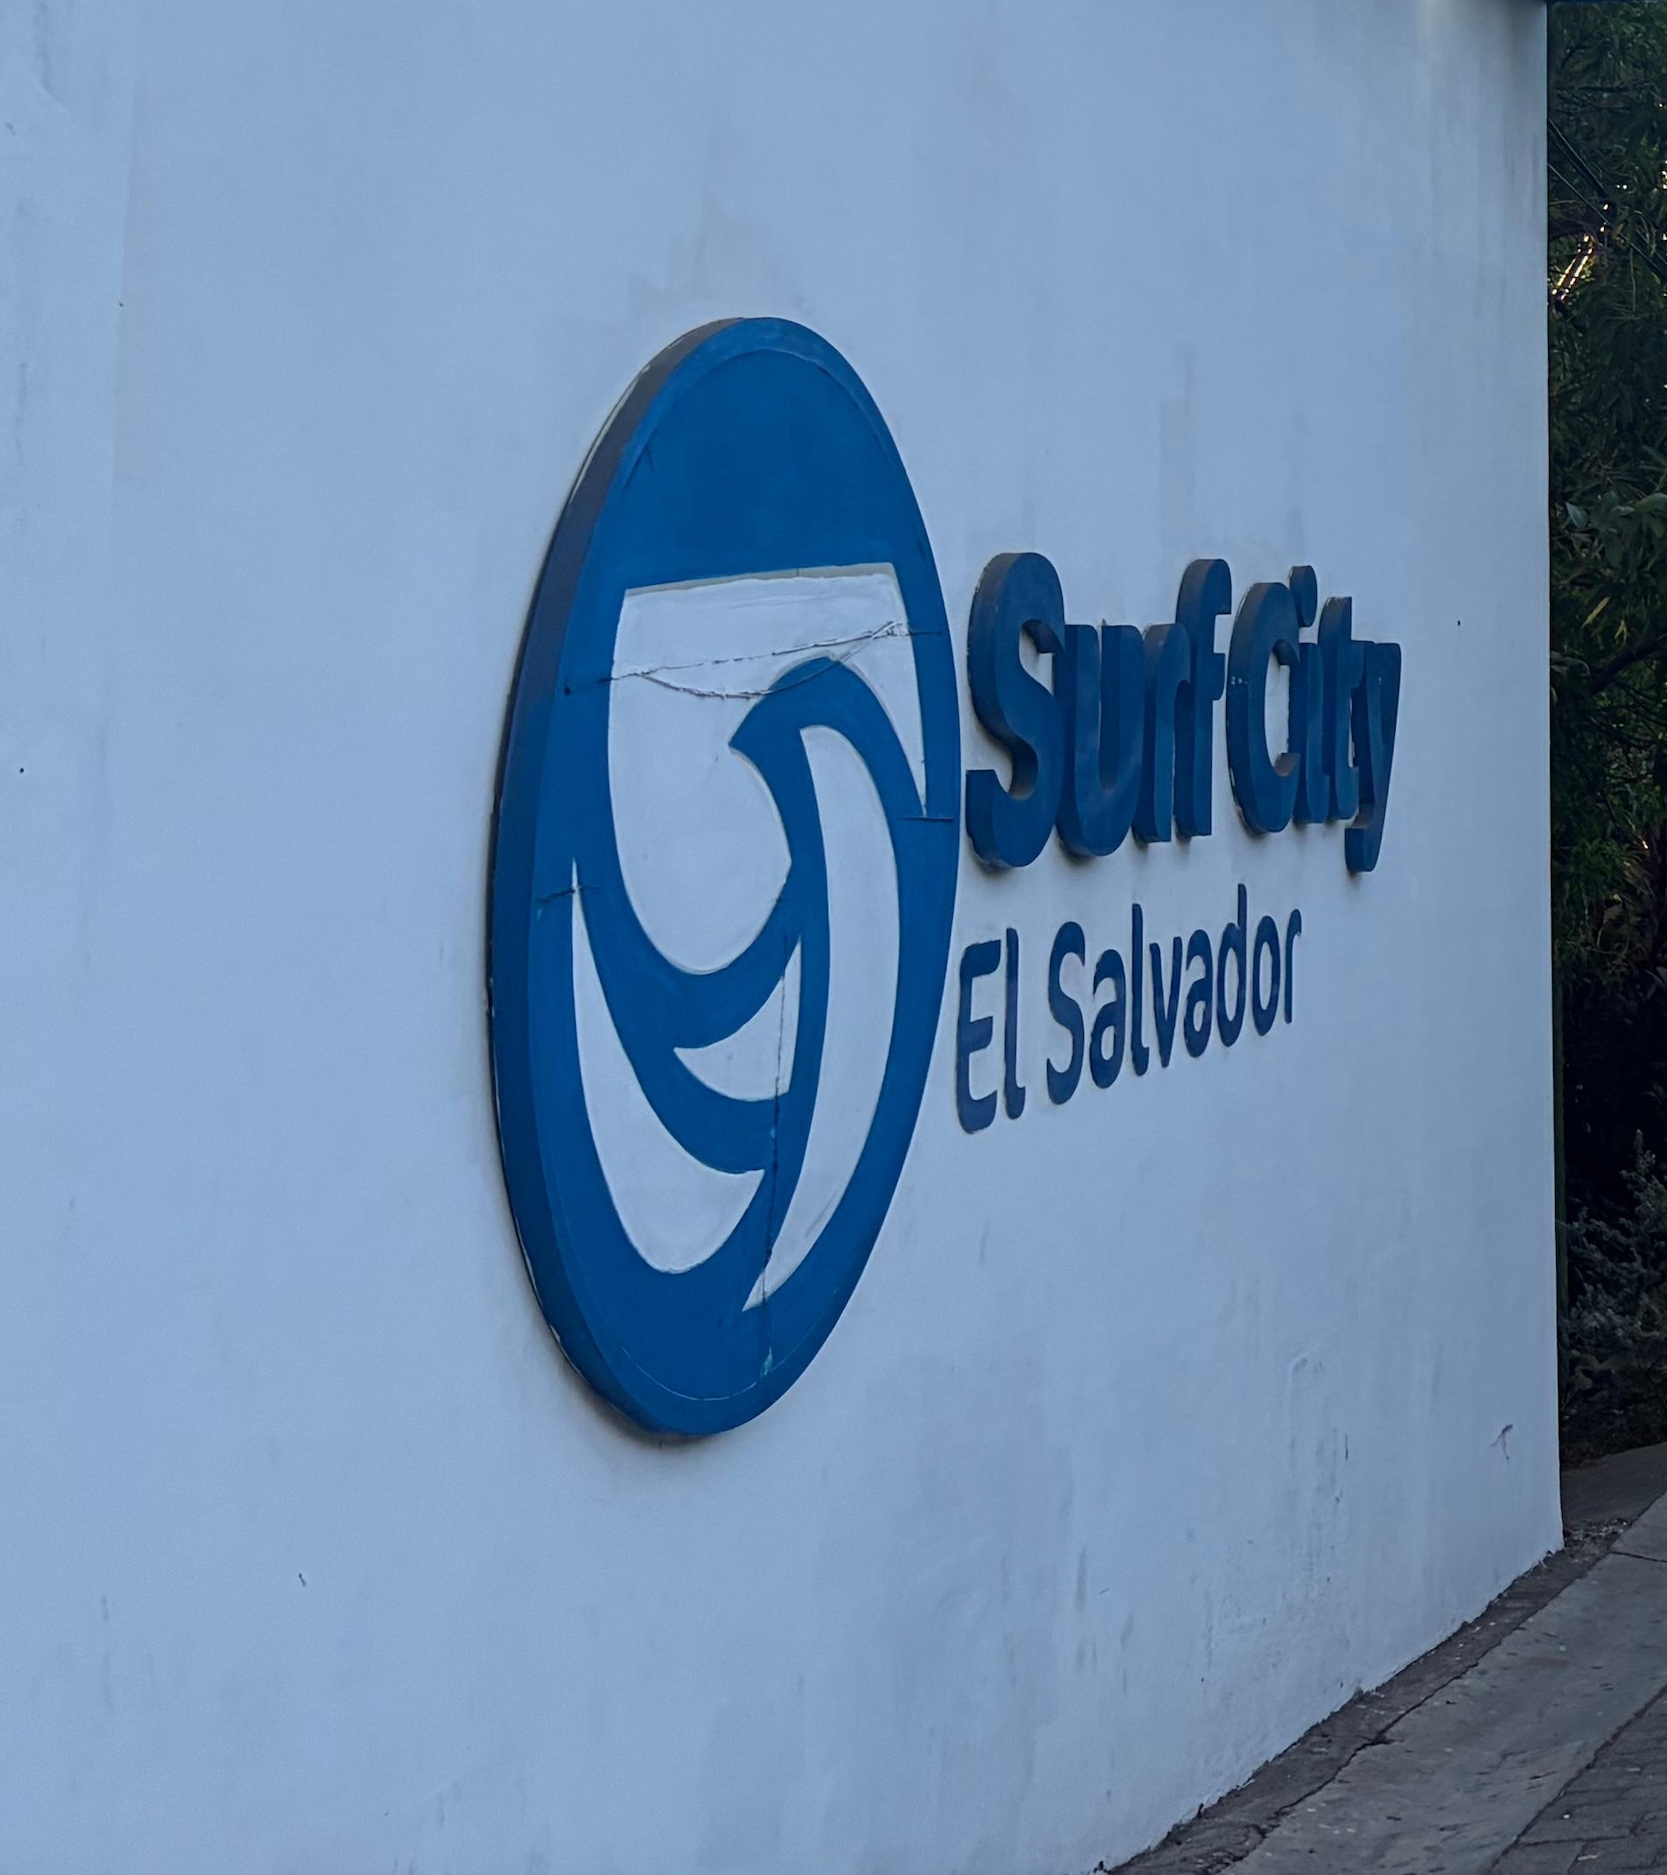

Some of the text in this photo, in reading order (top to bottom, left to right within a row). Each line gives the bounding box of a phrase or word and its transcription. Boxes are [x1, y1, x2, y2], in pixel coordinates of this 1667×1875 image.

[965, 549, 1402, 874] Surf City
[956, 883, 1303, 1134] El Salvador
